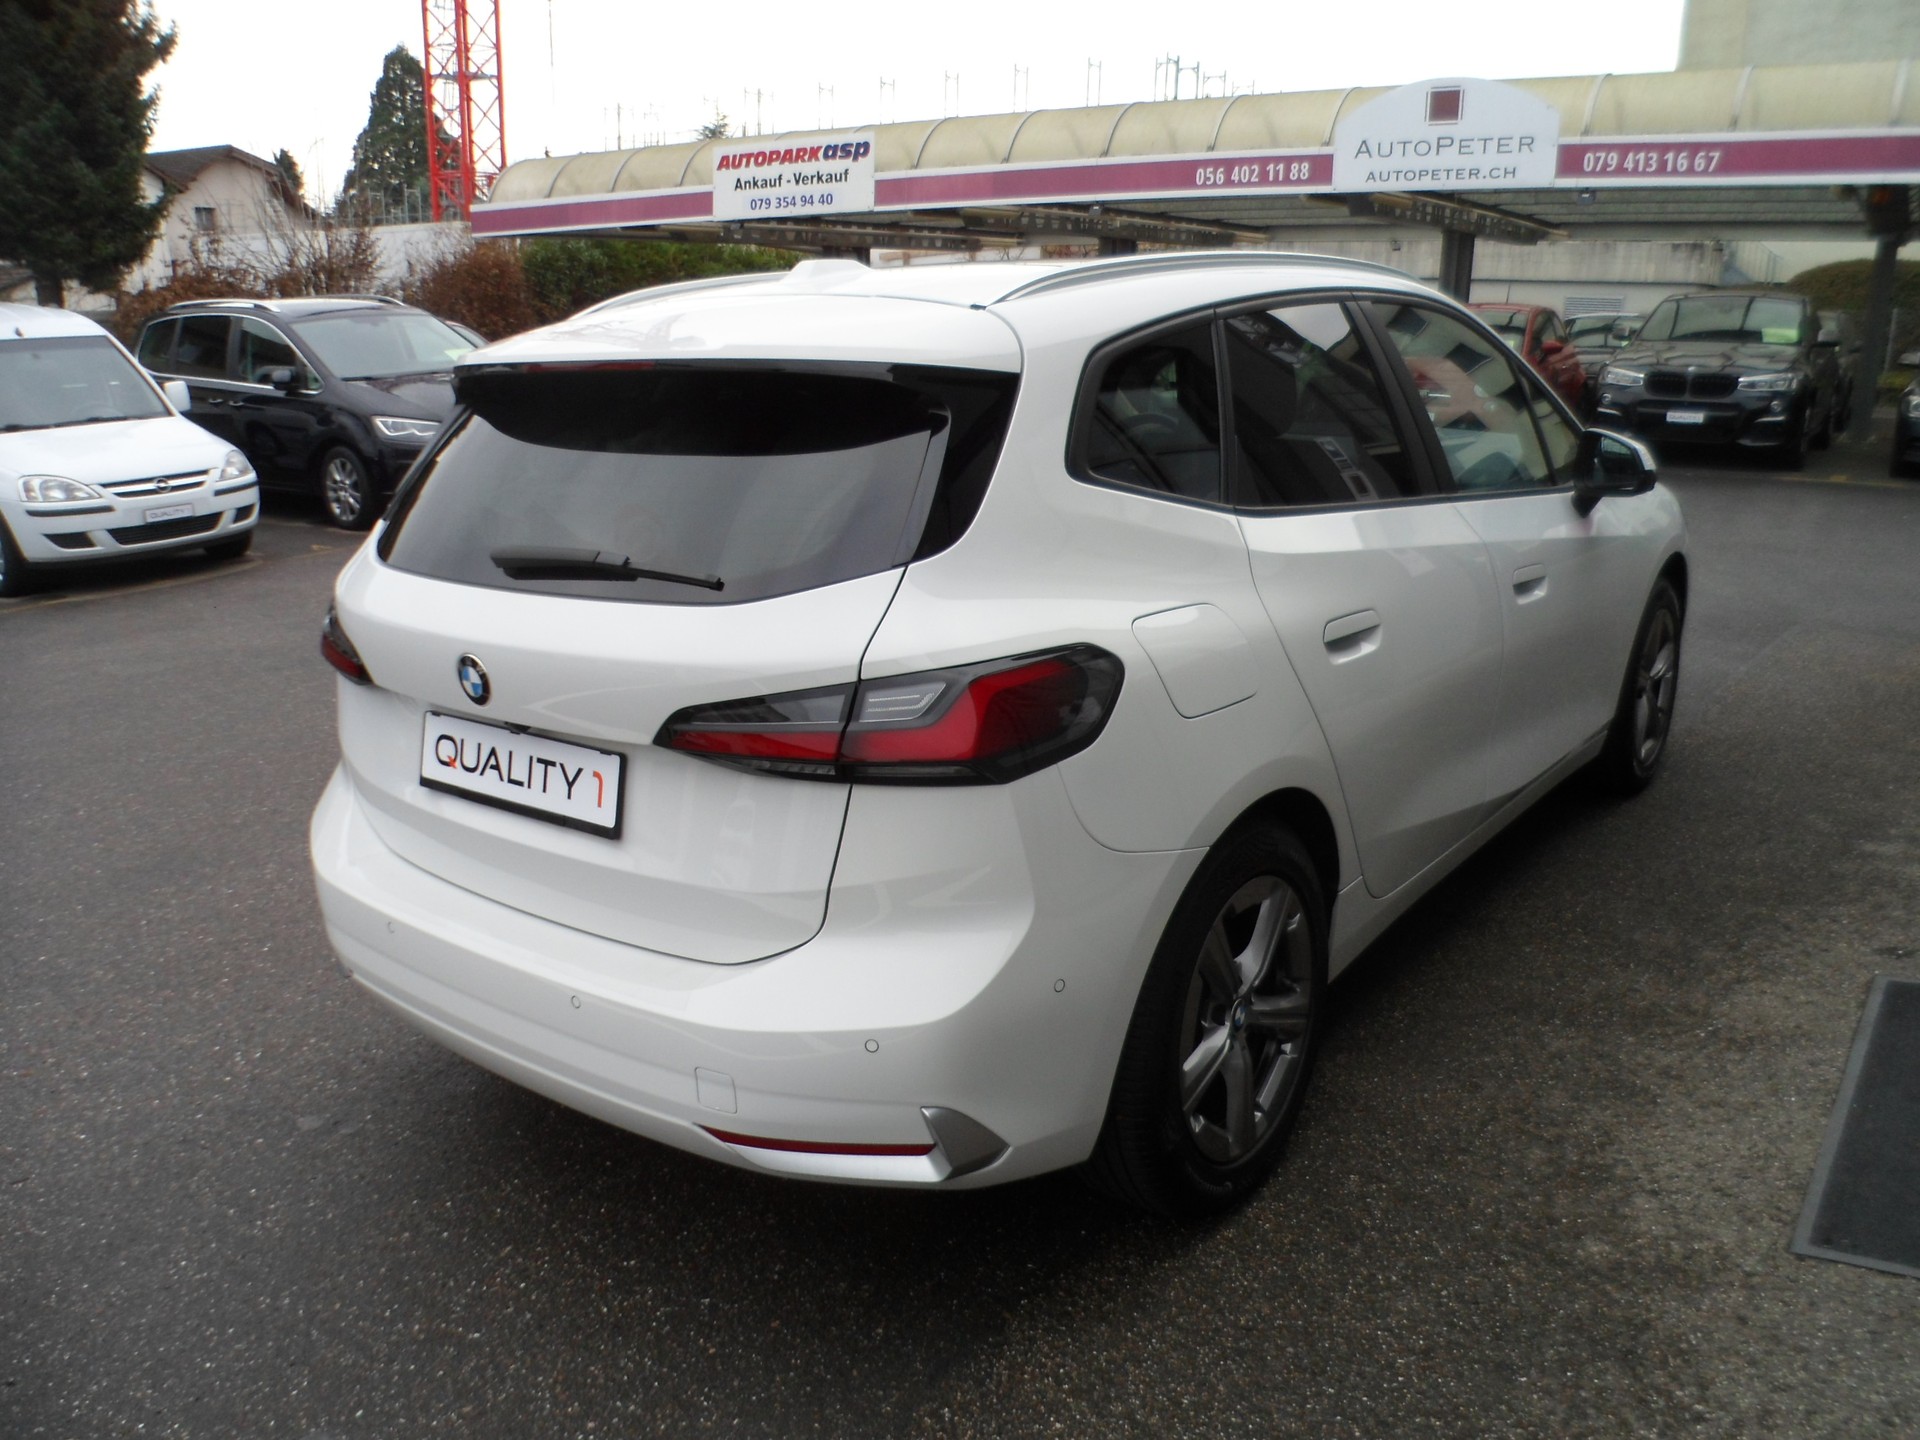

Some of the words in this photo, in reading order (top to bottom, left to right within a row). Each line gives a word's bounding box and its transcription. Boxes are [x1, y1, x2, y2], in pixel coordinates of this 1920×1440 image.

[1583, 152, 1618, 172] 079
[1623, 152, 1658, 172] 413
[1663, 152, 1688, 172] 16
[1693, 152, 1720, 172] 67
[734, 174, 783, 191] Ankauf
[793, 169, 850, 186] Verkauf
[1195, 167, 1225, 185] 056
[1231, 165, 1259, 183] 402
[1266, 163, 1284, 181] 11
[1289, 162, 1310, 180] 88
[1365, 167, 1516, 183] AUTOPETER.CH
[750, 198, 772, 211] 079
[775, 196, 797, 209] 354
[800, 195, 815, 207] 94
[818, 193, 834, 205] 40
